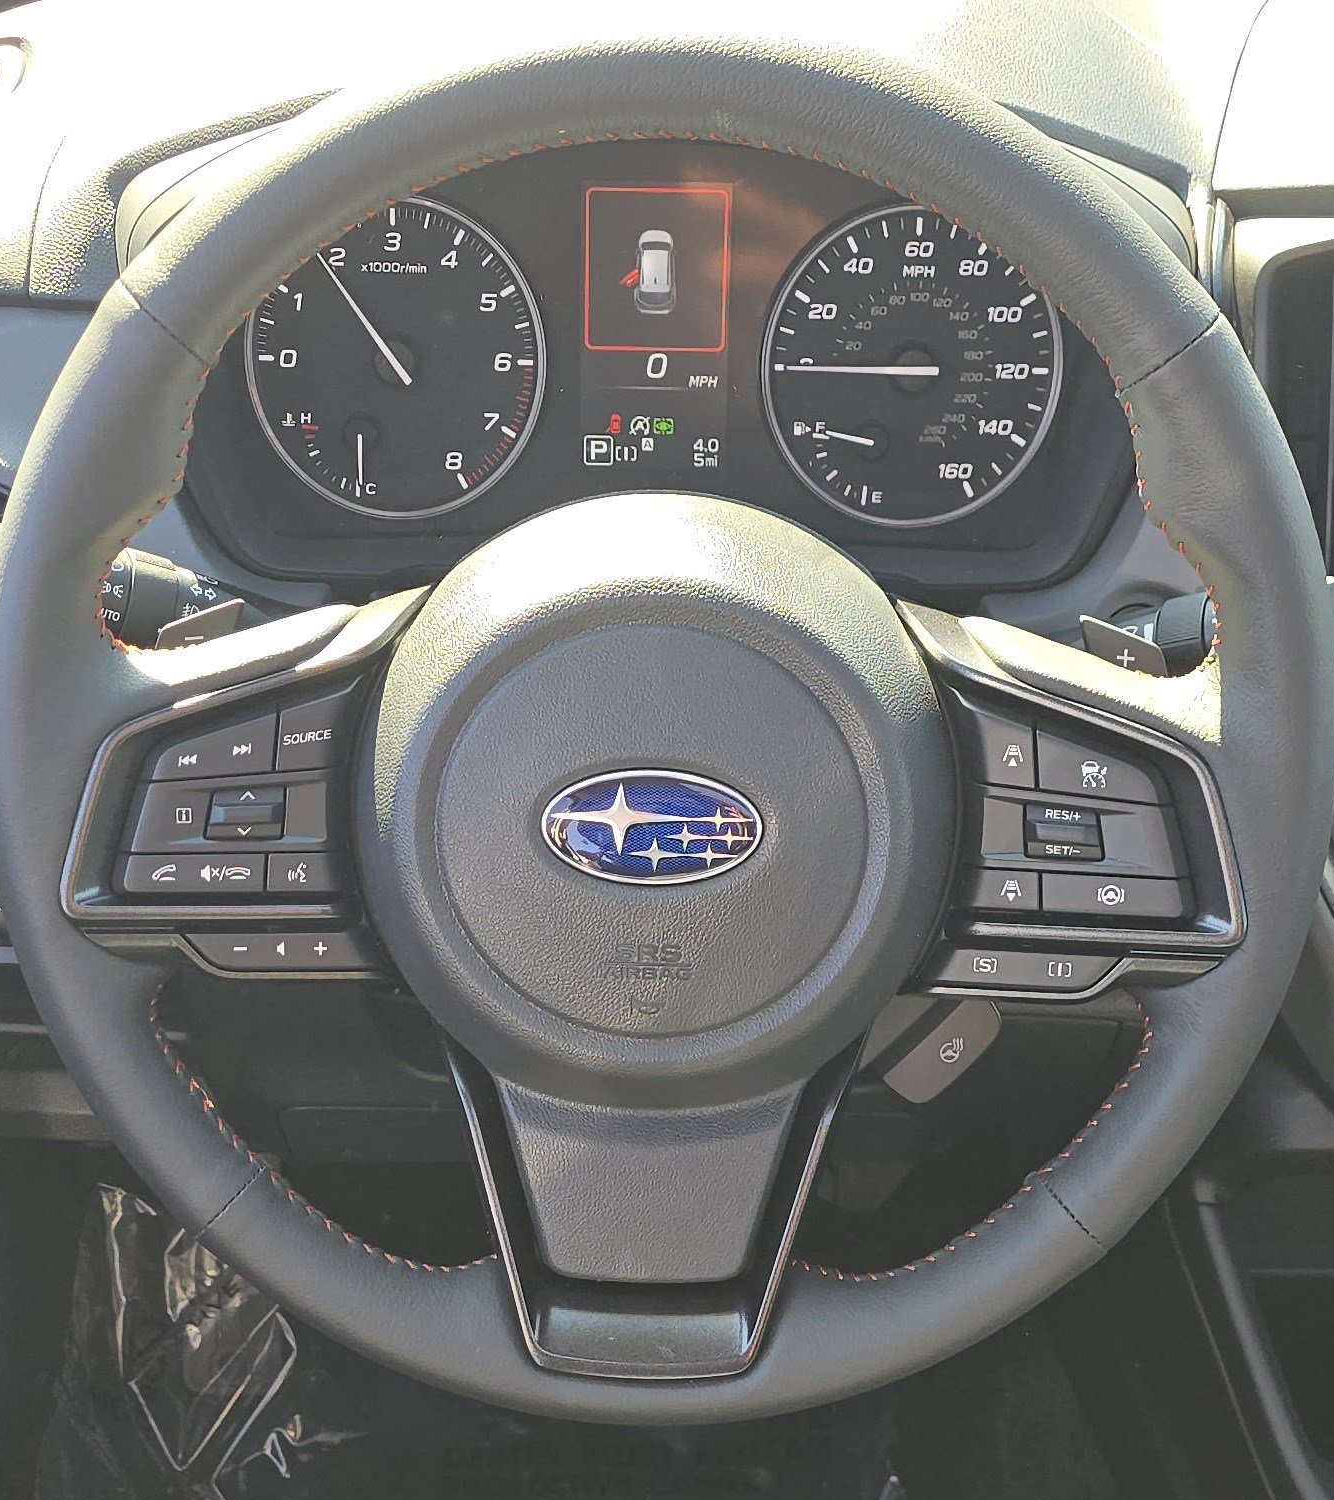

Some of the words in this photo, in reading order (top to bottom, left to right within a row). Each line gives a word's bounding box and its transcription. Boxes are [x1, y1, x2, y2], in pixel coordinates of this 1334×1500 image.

[383, 232, 401, 252] 3
[904, 241, 934, 257] 60
[328, 248, 346, 267] 2
[440, 251, 458, 268] 4
[843, 258, 874, 274] 40
[902, 265, 935, 277] MPH
[958, 260, 989, 276] 80
[293, 293, 304, 311] 1
[479, 293, 497, 312] 5
[808, 304, 837, 320] 20
[987, 306, 1022, 323] 100
[279, 349, 297, 368] 0
[494, 353, 512, 372] 6
[647, 353, 667, 378] 0
[994, 364, 1029, 380] 120
[688, 376, 718, 388] MPH
[300, 413, 312, 424] H
[483, 413, 500, 431] 7
[815, 422, 825, 433] F
[978, 419, 1014, 436] 140
[590, 440, 607, 460] P
[445, 452, 463, 470] 8
[938, 463, 973, 480] 160
[365, 483, 377, 495] C
[872, 491, 882, 503] E
[101, 608, 121, 622] UTO
[282, 728, 332, 746] SOURCE
[1045, 809, 1082, 822] RES/+
